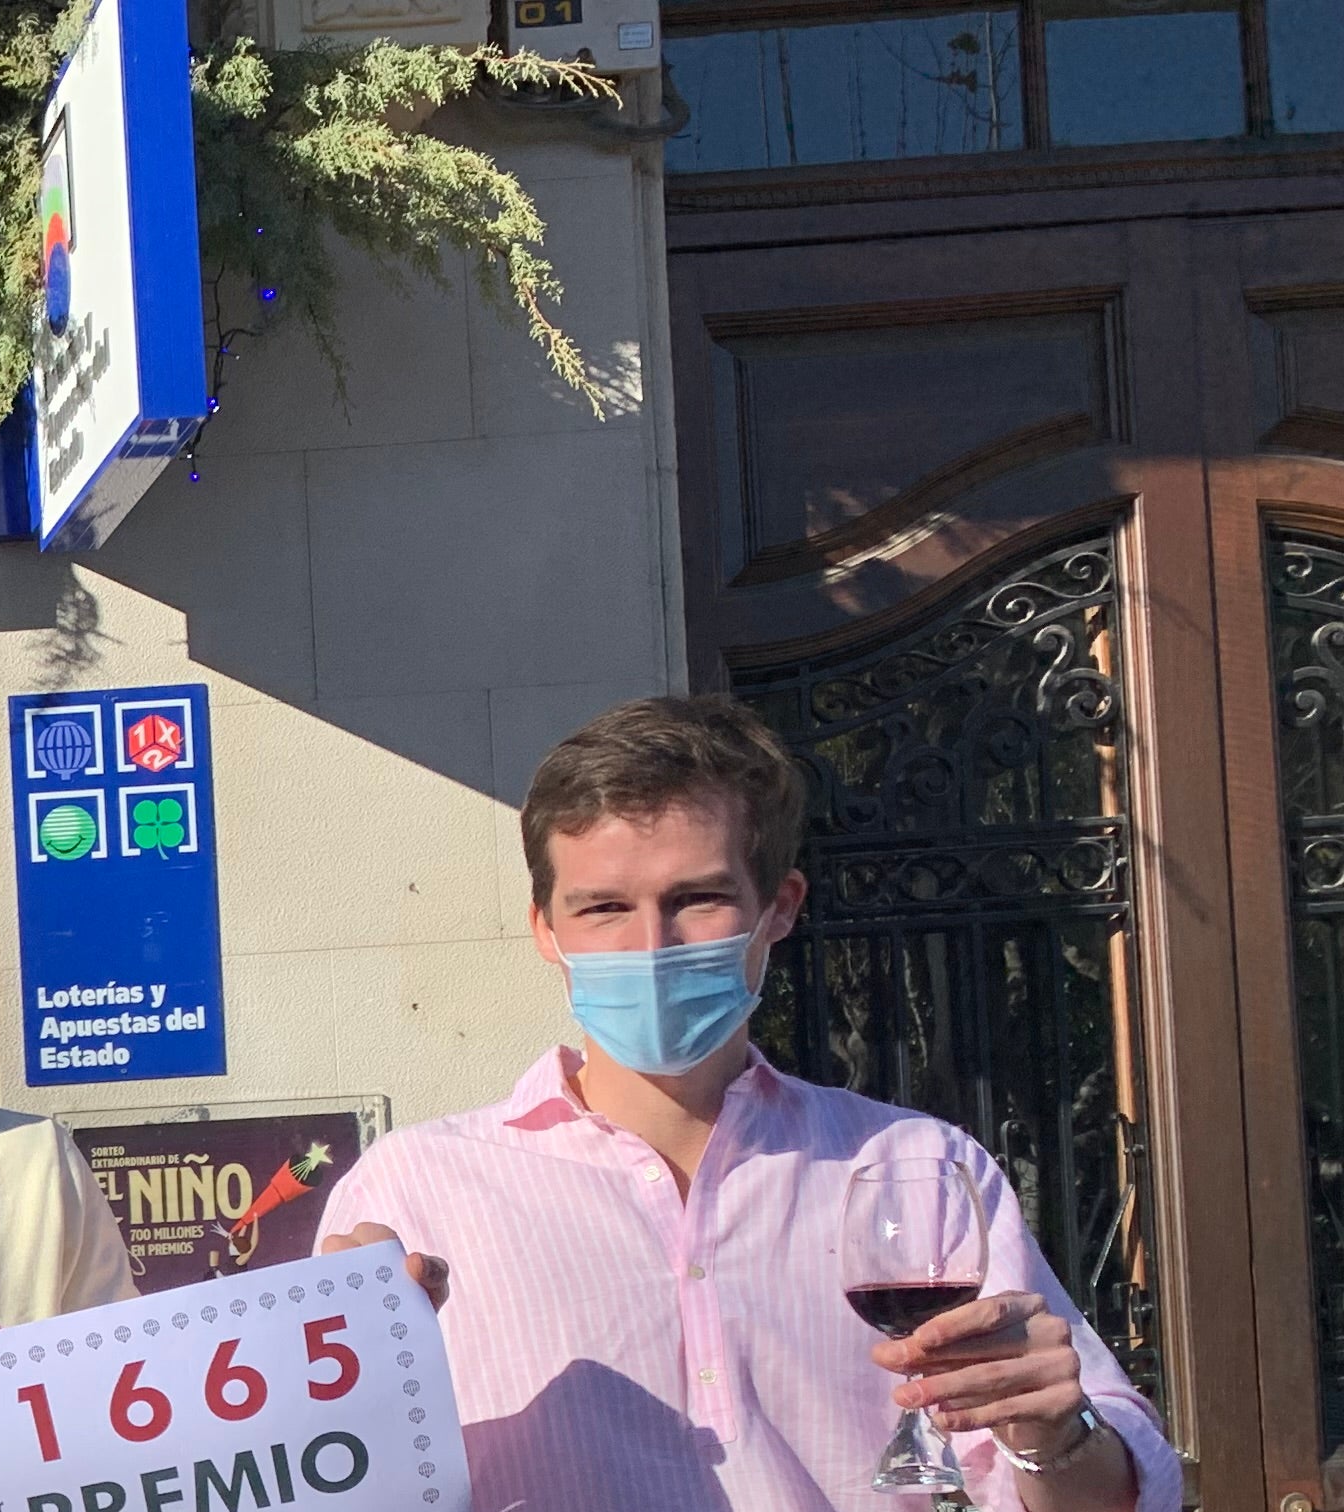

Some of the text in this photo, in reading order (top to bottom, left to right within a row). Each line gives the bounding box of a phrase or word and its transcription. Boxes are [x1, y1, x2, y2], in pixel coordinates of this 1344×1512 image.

[37, 981, 167, 1010] Loterías y
[40, 1006, 206, 1044] Apuestas del
[40, 1043, 131, 1070] Estado
[91, 1146, 125, 1158] SORTEO
[92, 1154, 180, 1169] EXTRAORDINARIO DE
[128, 1152, 254, 1225] NIÑO
[130, 1225, 205, 1242] 700 MILLONES
[131, 1241, 194, 1257] EN PREMIOS
